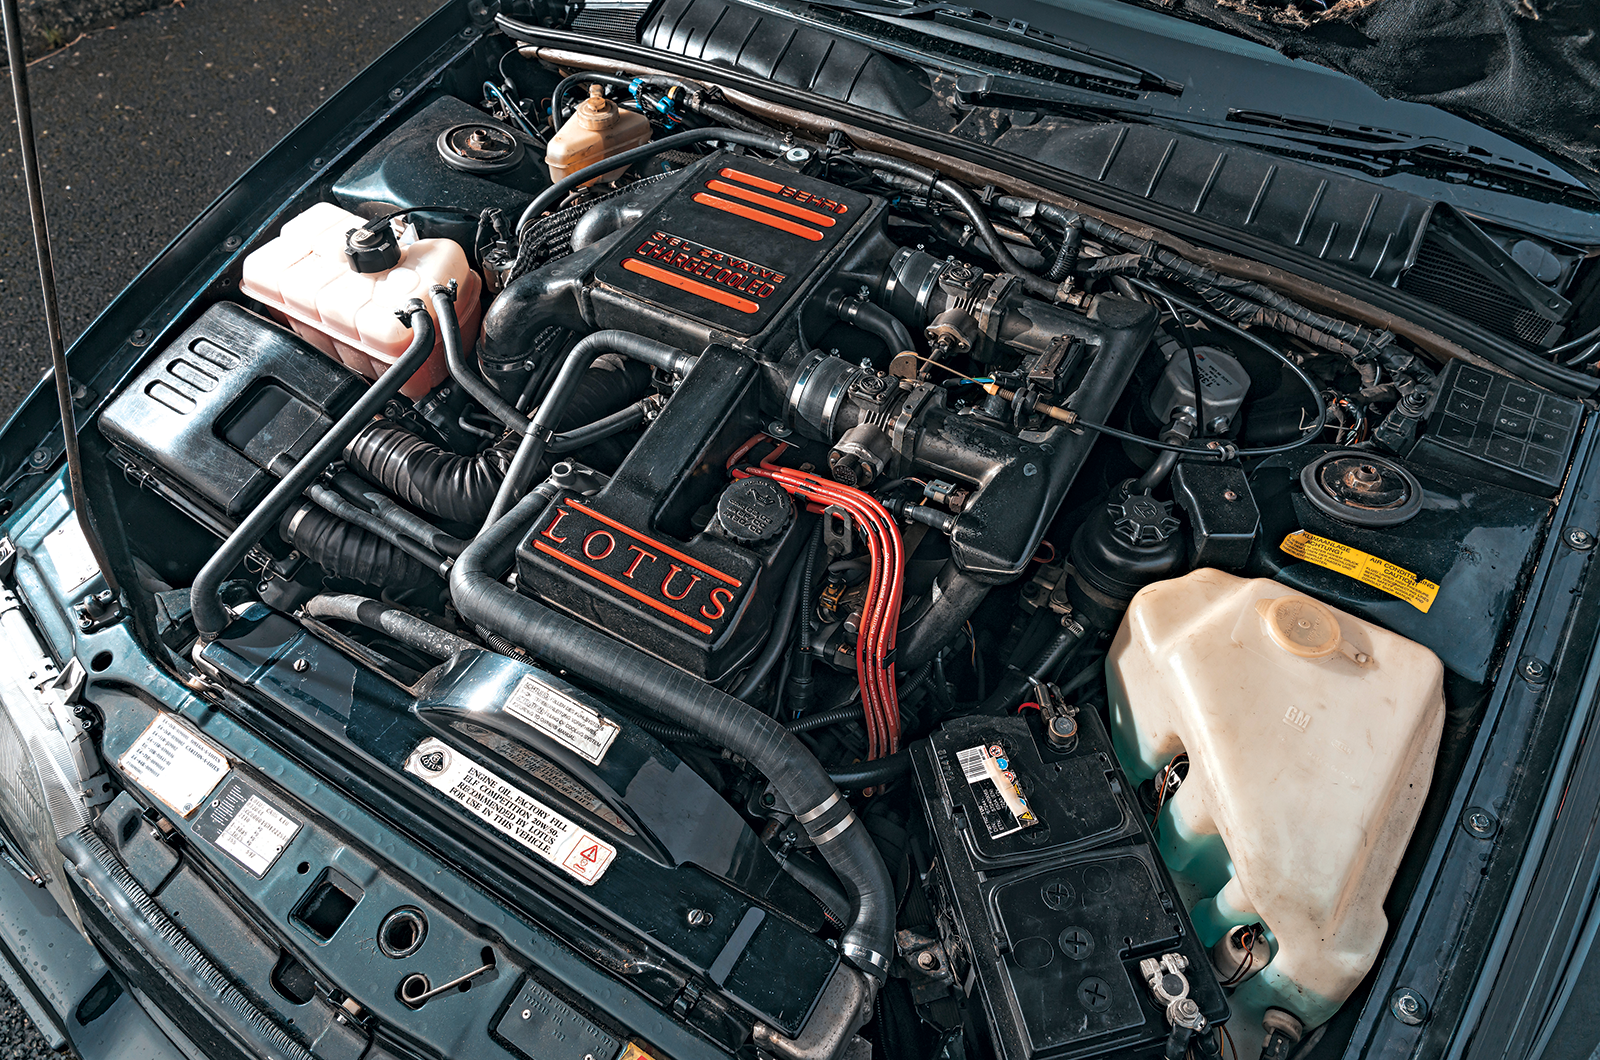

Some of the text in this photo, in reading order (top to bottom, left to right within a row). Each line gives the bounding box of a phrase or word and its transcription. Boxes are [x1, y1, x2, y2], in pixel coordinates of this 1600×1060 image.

[636, 240, 776, 298] CHARGECOOLED
[727, 256, 787, 284] VALVE
[1302, 531, 1352, 554] KLIMAANLAGE
[1305, 539, 1344, 556] ACHTUNG!
[540, 508, 734, 620] LOTUS
[1370, 557, 1383, 566] AIR
[1384, 568, 1418, 588] CAUTION!
[870, 599, 883, 634] COMPETITION
[1284, 706, 1310, 728] GM
[423, 756, 443, 772] LOTUS
[463, 774, 559, 838] ELF COMPETITION 20W/50.
[468, 766, 498, 788] ENGINE
[498, 785, 512, 800] OIL,
[516, 795, 551, 820] FACTORY
[450, 786, 551, 855] FOR USE IN THIS VEHICLE.
[457, 778, 556, 846] RECOMMENDED BY LOTUS
